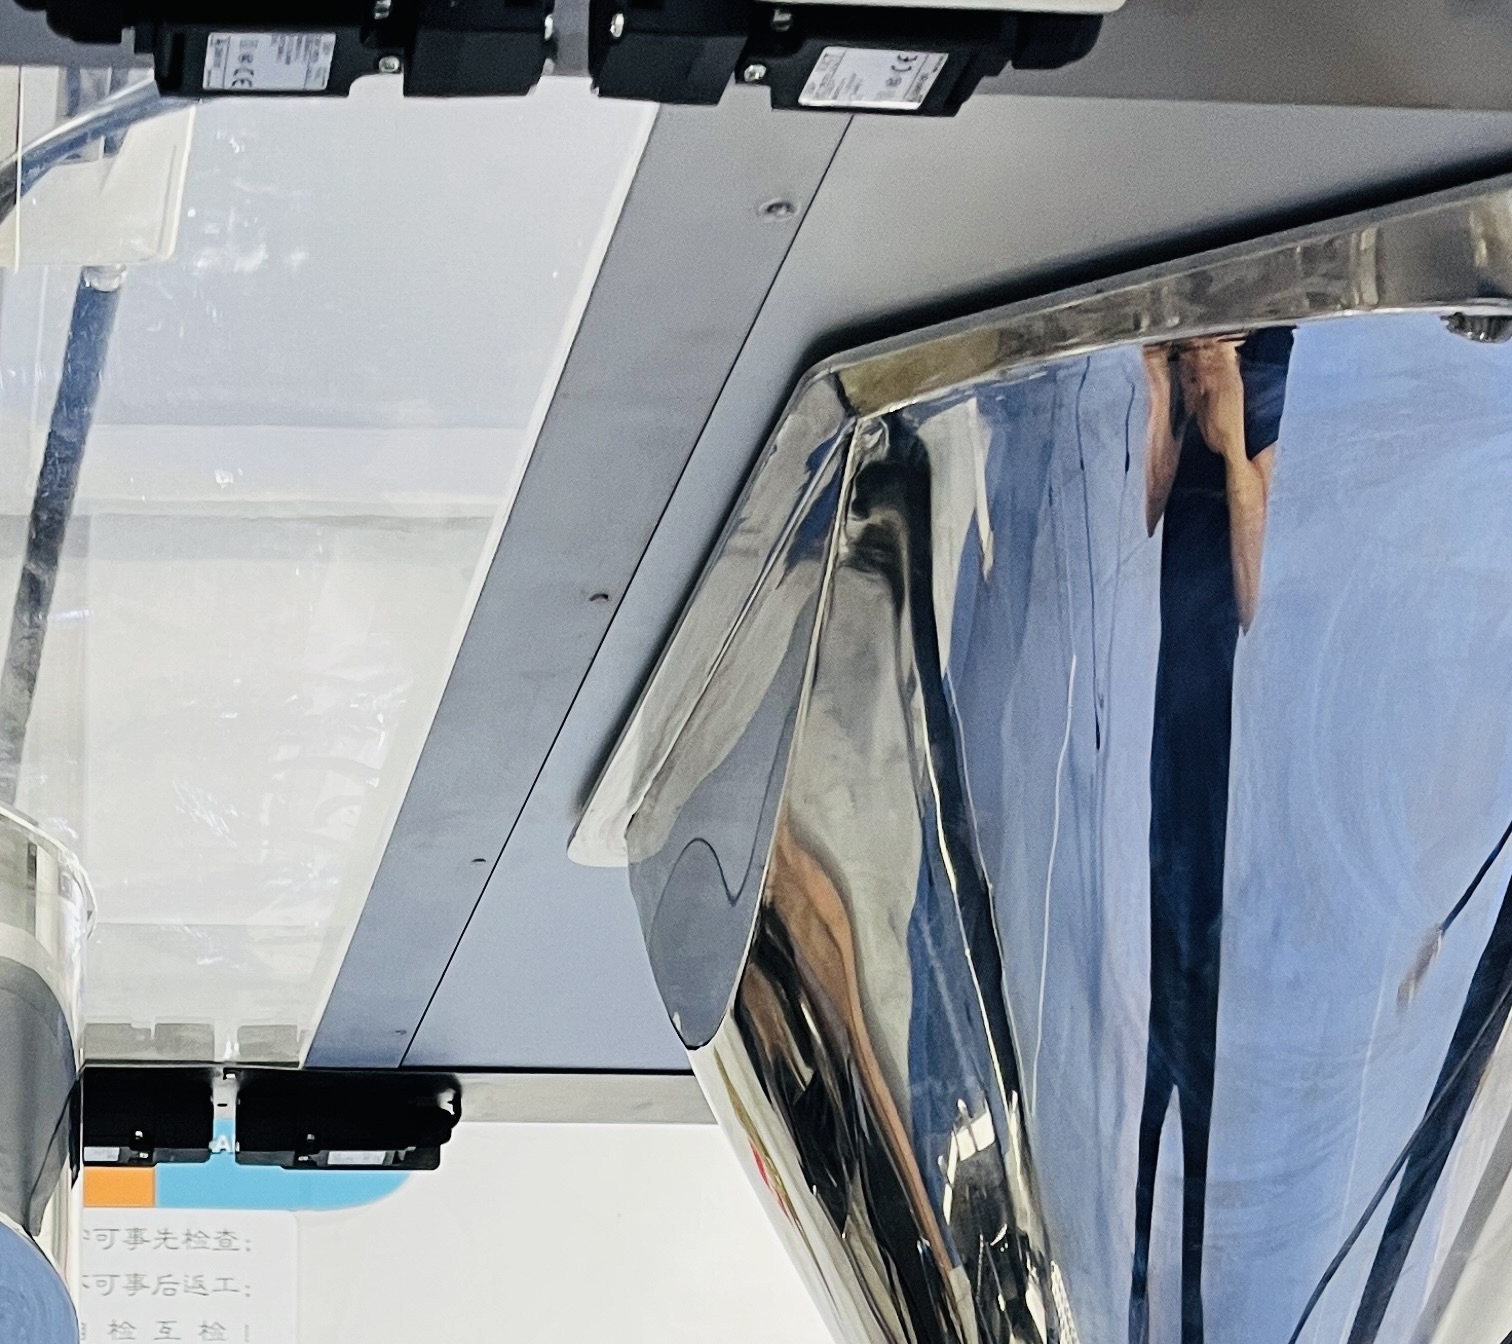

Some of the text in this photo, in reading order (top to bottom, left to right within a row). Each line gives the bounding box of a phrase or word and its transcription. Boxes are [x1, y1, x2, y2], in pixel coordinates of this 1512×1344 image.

[82, 1226, 252, 1252] 可事先检查；
[81, 1272, 252, 1297] 可事后返工；
